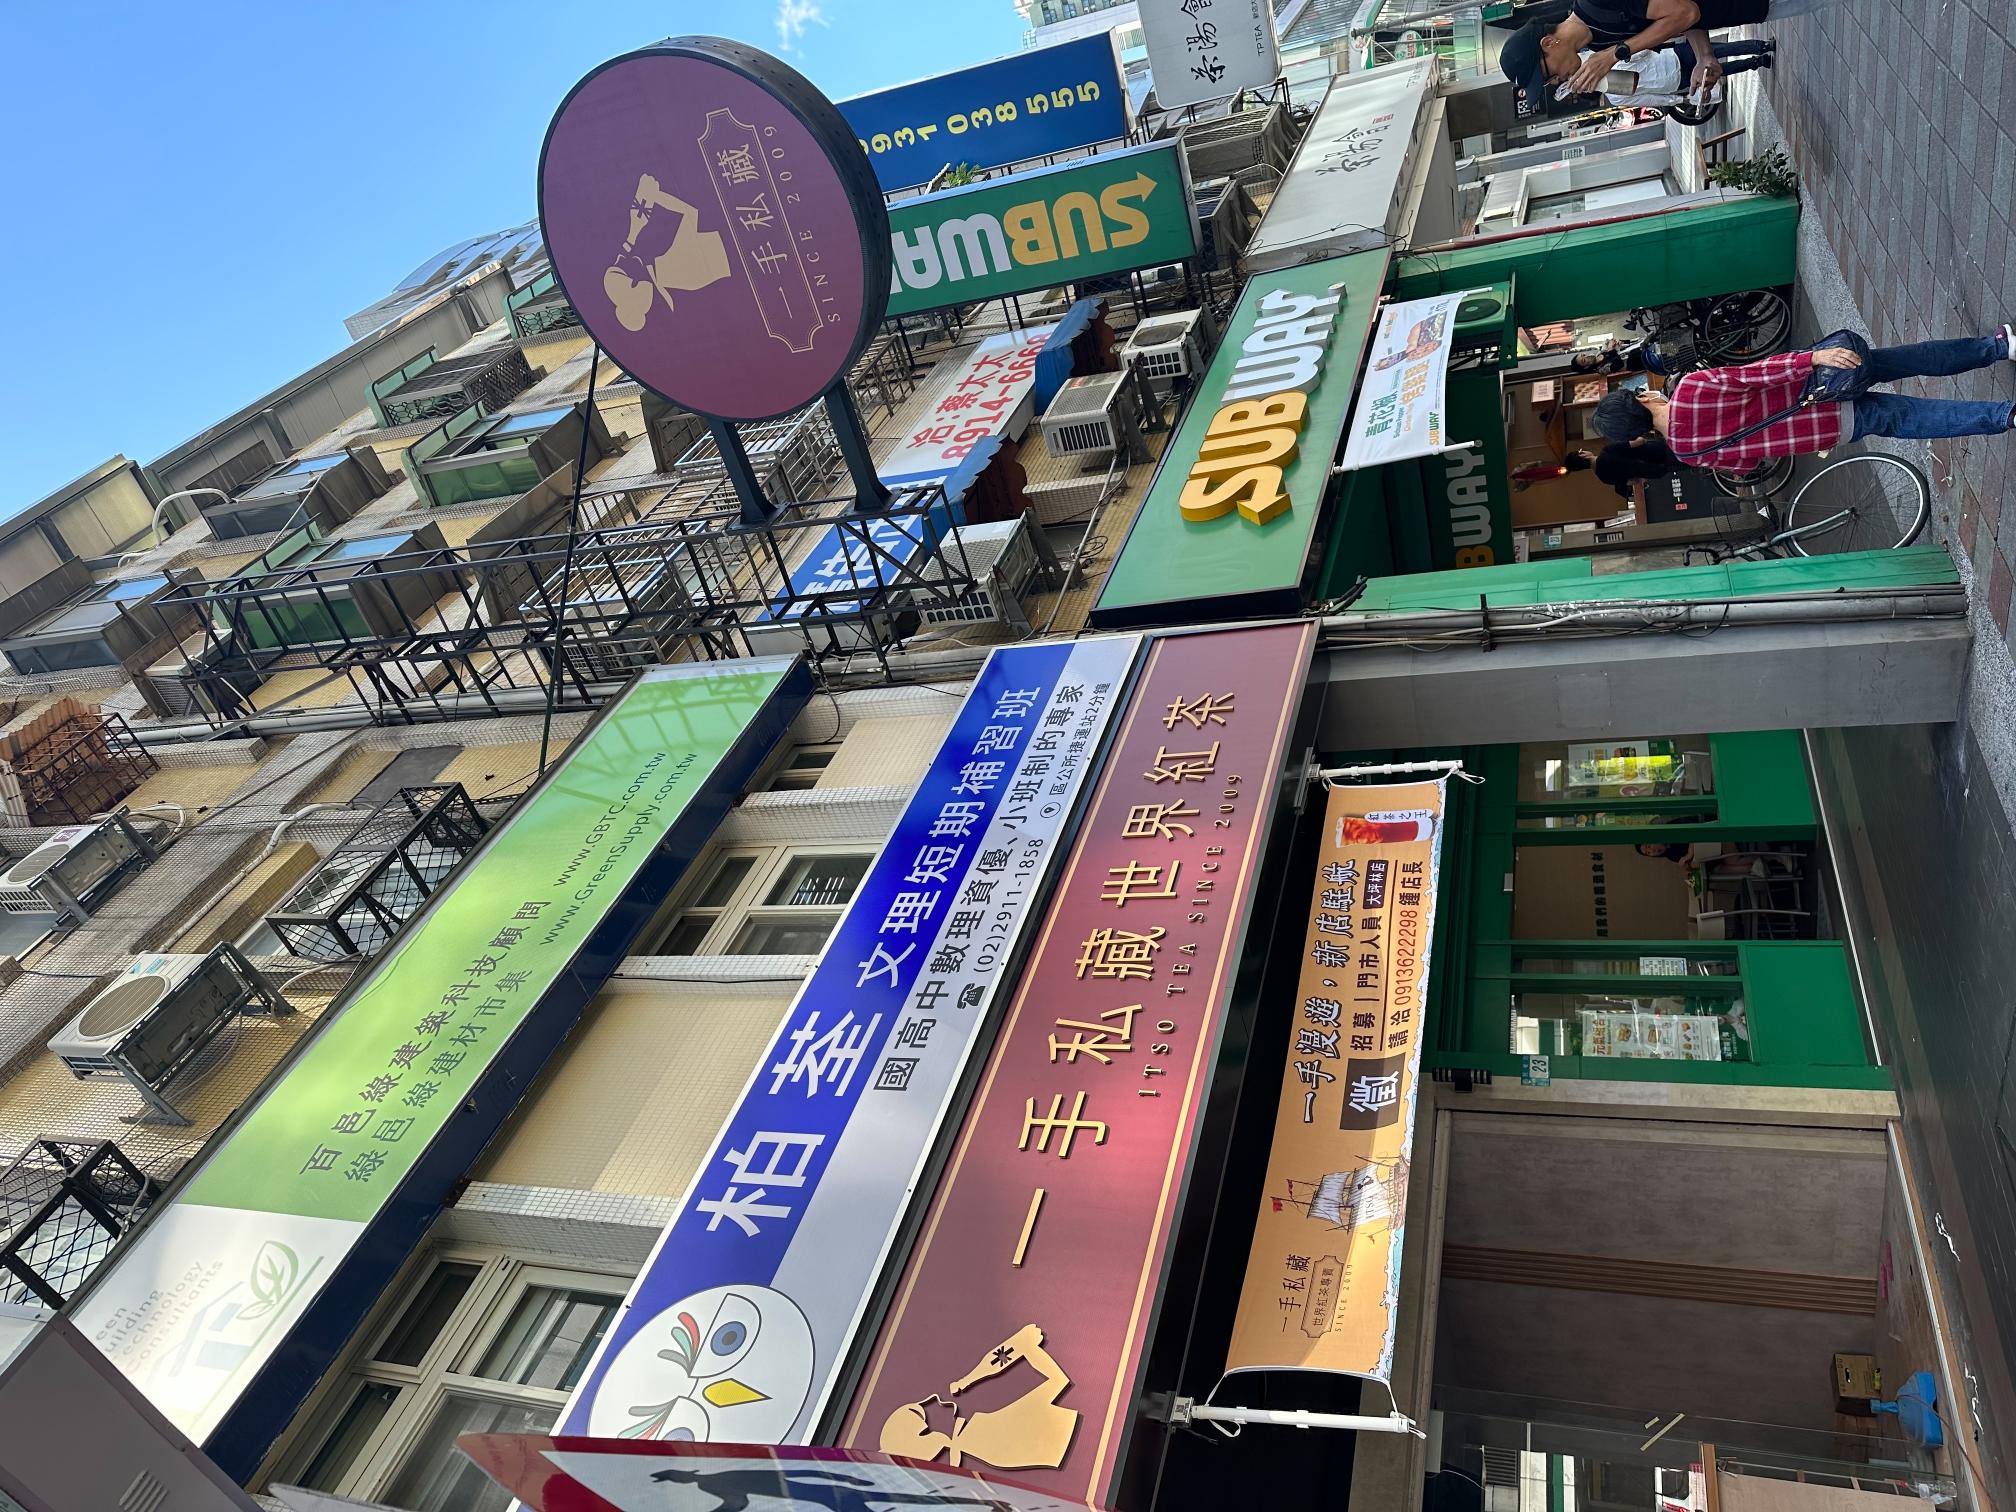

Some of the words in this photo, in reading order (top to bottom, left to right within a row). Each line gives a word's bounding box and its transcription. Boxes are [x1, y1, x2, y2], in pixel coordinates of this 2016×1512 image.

[763, 124, 802, 204] 2009
[858, 124, 938, 155] 931
[946, 101, 1018, 135] 038
[1025, 81, 1101, 115] 555
[715, 143, 793, 320] 一手私藏
[799, 229, 841, 323] SINCE
[888, 171, 1158, 294] SUBWA
[1178, 289, 1345, 525] SUBWAY
[1428, 411, 1440, 446] SUBWAY
[1446, 437, 1495, 567] BWAY
[1048, 682, 1112, 796] 區公所捷運站2分鐘
[973, 838, 1045, 974] (02)2911-1858
[1366, 862, 1387, 905] 大坪林店
[298, 899, 552, 1175] 百邑綠建築科技顧問
[553, 751, 667, 887] www.GBTC.com.tw
[343, 969, 533, 1183] 綠邑綠建材市集
[539, 752, 698, 946] www.GreenSupply.com.tw
[695, 1010, 884, 1238] 柏荃
[854, 686, 1042, 989] 文理短期補習班
[1010, 690, 1237, 1269] 一手私藏世界紅茶
[1136, 1018, 1177, 1098] ITSO
[1165, 941, 1199, 995] TEA
[1186, 844, 1226, 923] SINCE
[1212, 773, 1244, 828] 2009
[1393, 909, 1419, 1006] 0913622298
[1387, 1008, 1412, 1049] 請洽
[1531, 1059, 1547, 1073] 23
[1347, 1070, 1400, 1113] 徵
[94, 1307, 127, 1342] een
[103, 1289, 164, 1354] uilding
[120, 1260, 203, 1357] echnology
[1277, 1253, 1311, 1333] 一手私藏
[1334, 1298, 1349, 1332] SINCE
[1341, 1263, 1353, 1291] 2009
